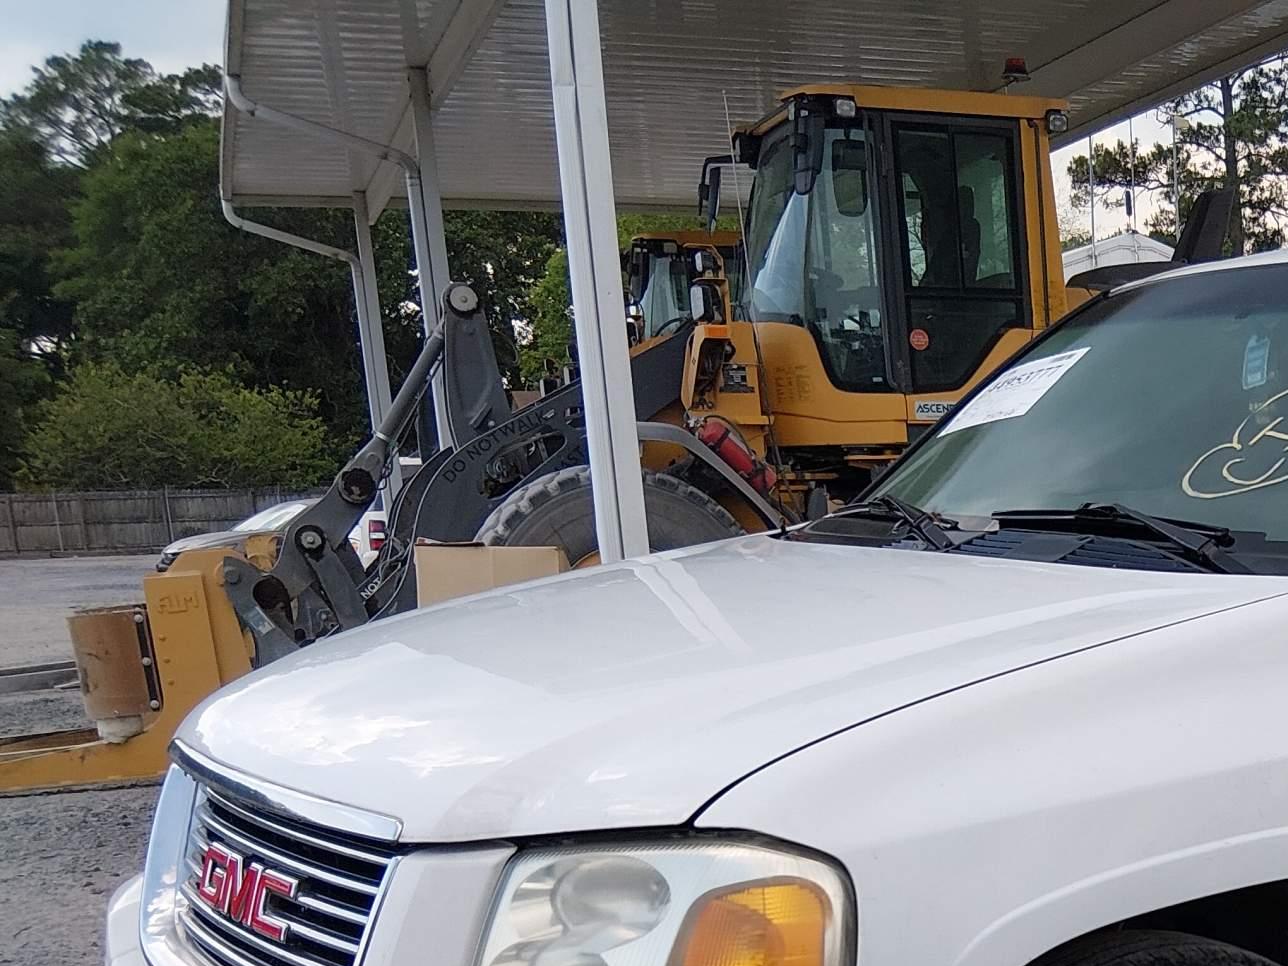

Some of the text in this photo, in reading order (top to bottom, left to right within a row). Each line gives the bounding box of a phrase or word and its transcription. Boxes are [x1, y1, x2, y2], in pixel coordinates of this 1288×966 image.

[442, 459, 466, 483] DO
[467, 429, 500, 461] NOT
[198, 841, 298, 944] GMC
